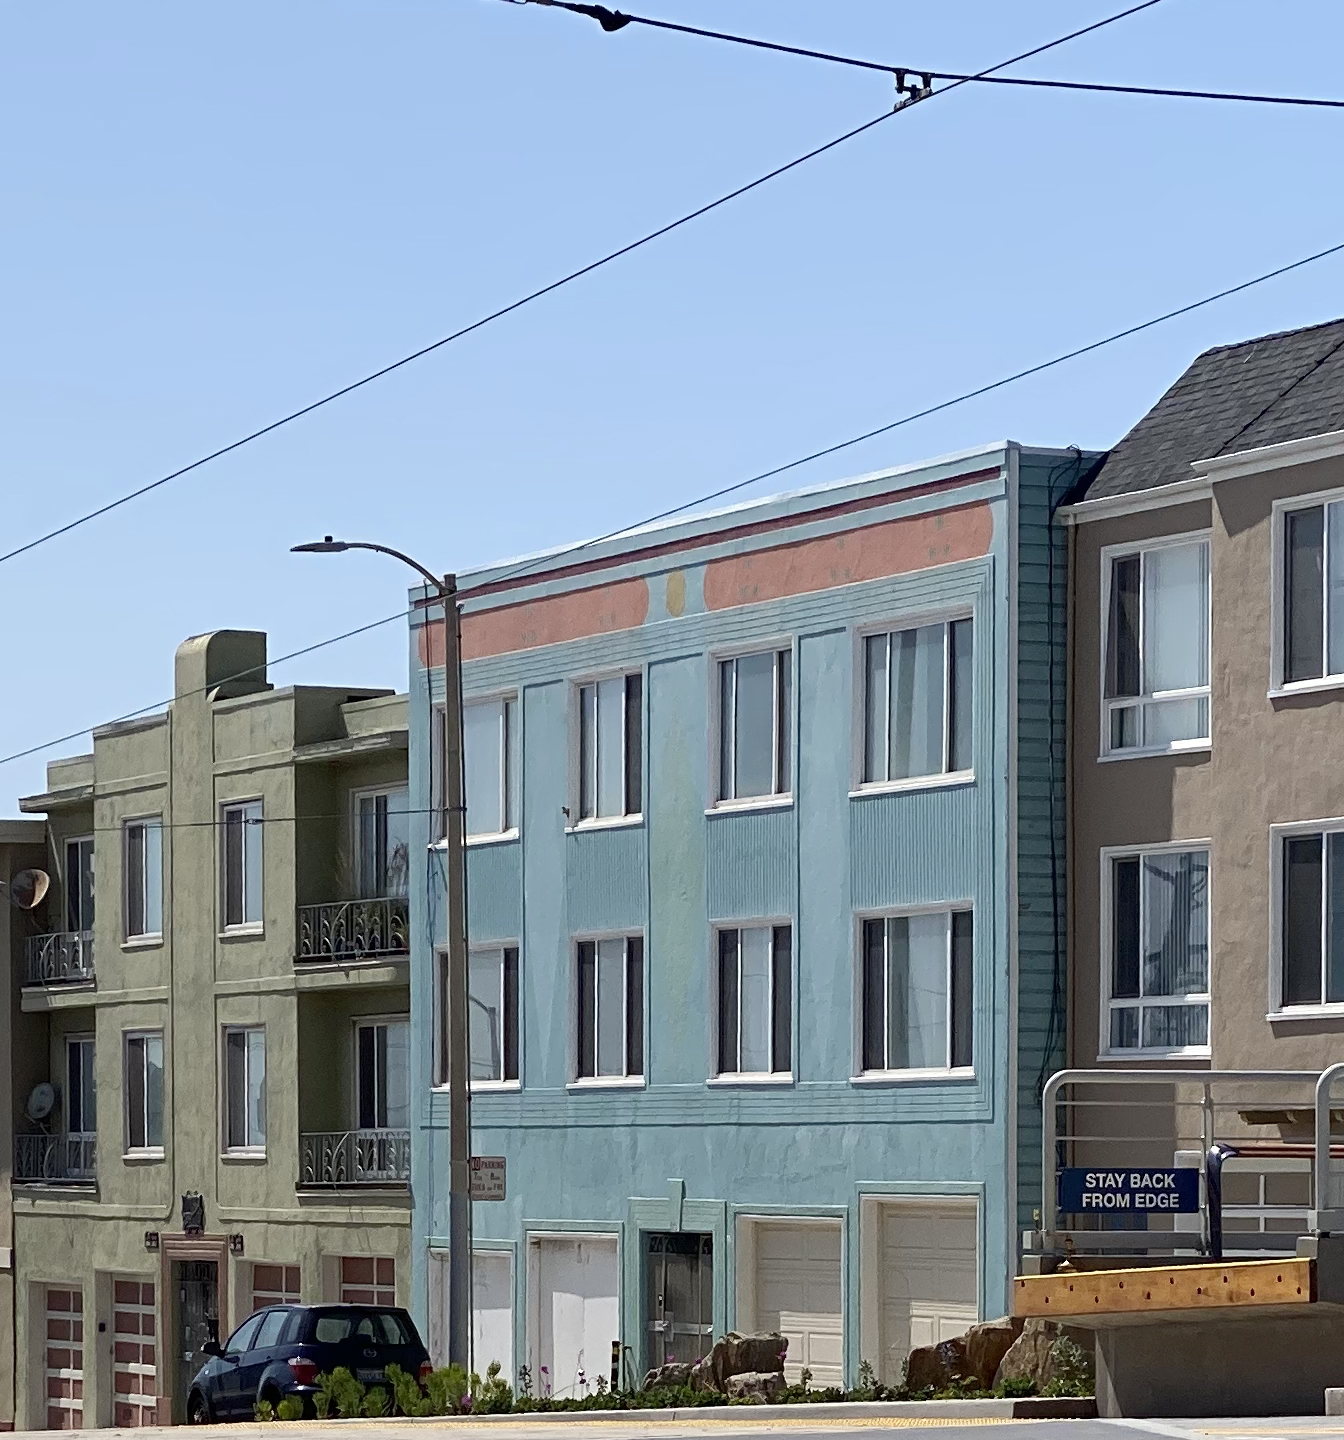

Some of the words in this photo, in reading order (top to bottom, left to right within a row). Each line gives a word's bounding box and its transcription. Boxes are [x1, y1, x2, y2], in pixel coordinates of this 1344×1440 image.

[1085, 1173, 1126, 1188] STAY
[1130, 1173, 1176, 1188] BACK
[1082, 1193, 1130, 1208] FROM
[1135, 1193, 1180, 1208] EDGE
